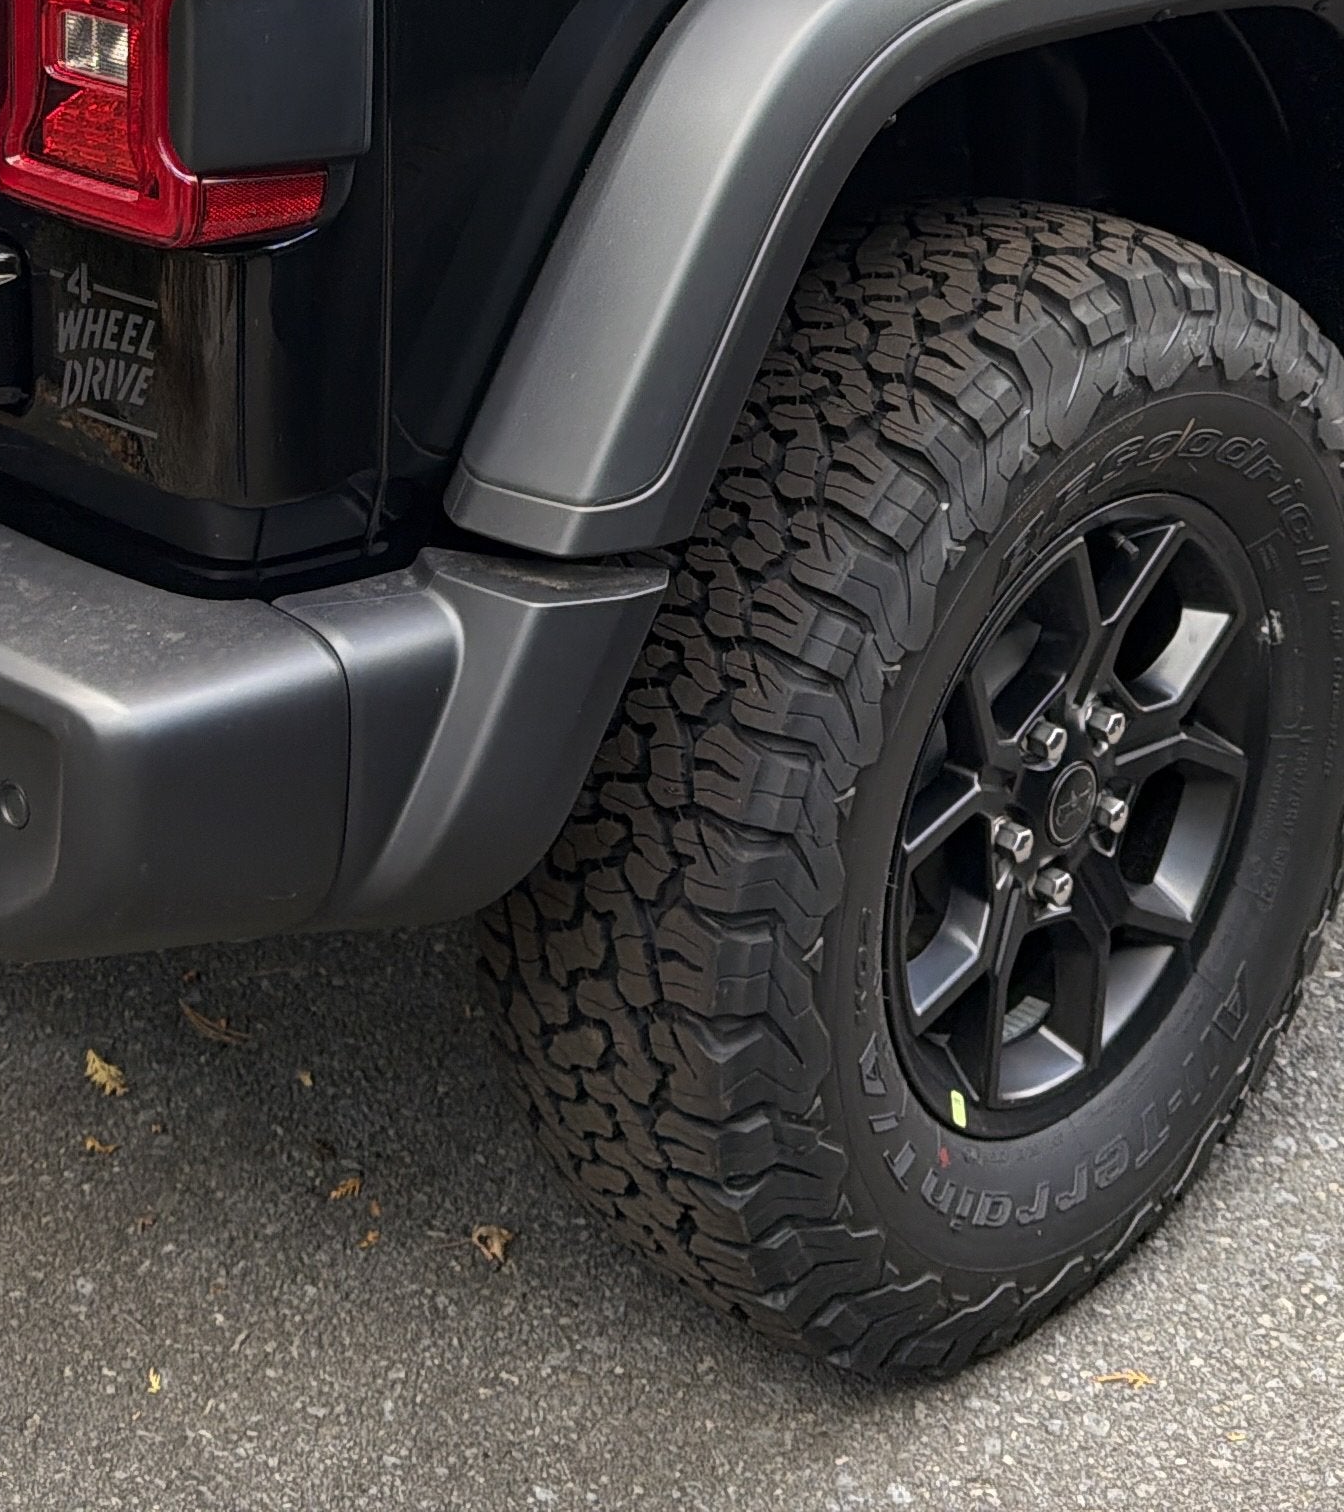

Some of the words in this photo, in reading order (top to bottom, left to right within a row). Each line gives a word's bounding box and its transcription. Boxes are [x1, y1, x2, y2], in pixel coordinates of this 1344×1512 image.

[66, 262, 93, 305] 4
[57, 307, 156, 361] WHEEL
[60, 356, 155, 409] DRIVE
